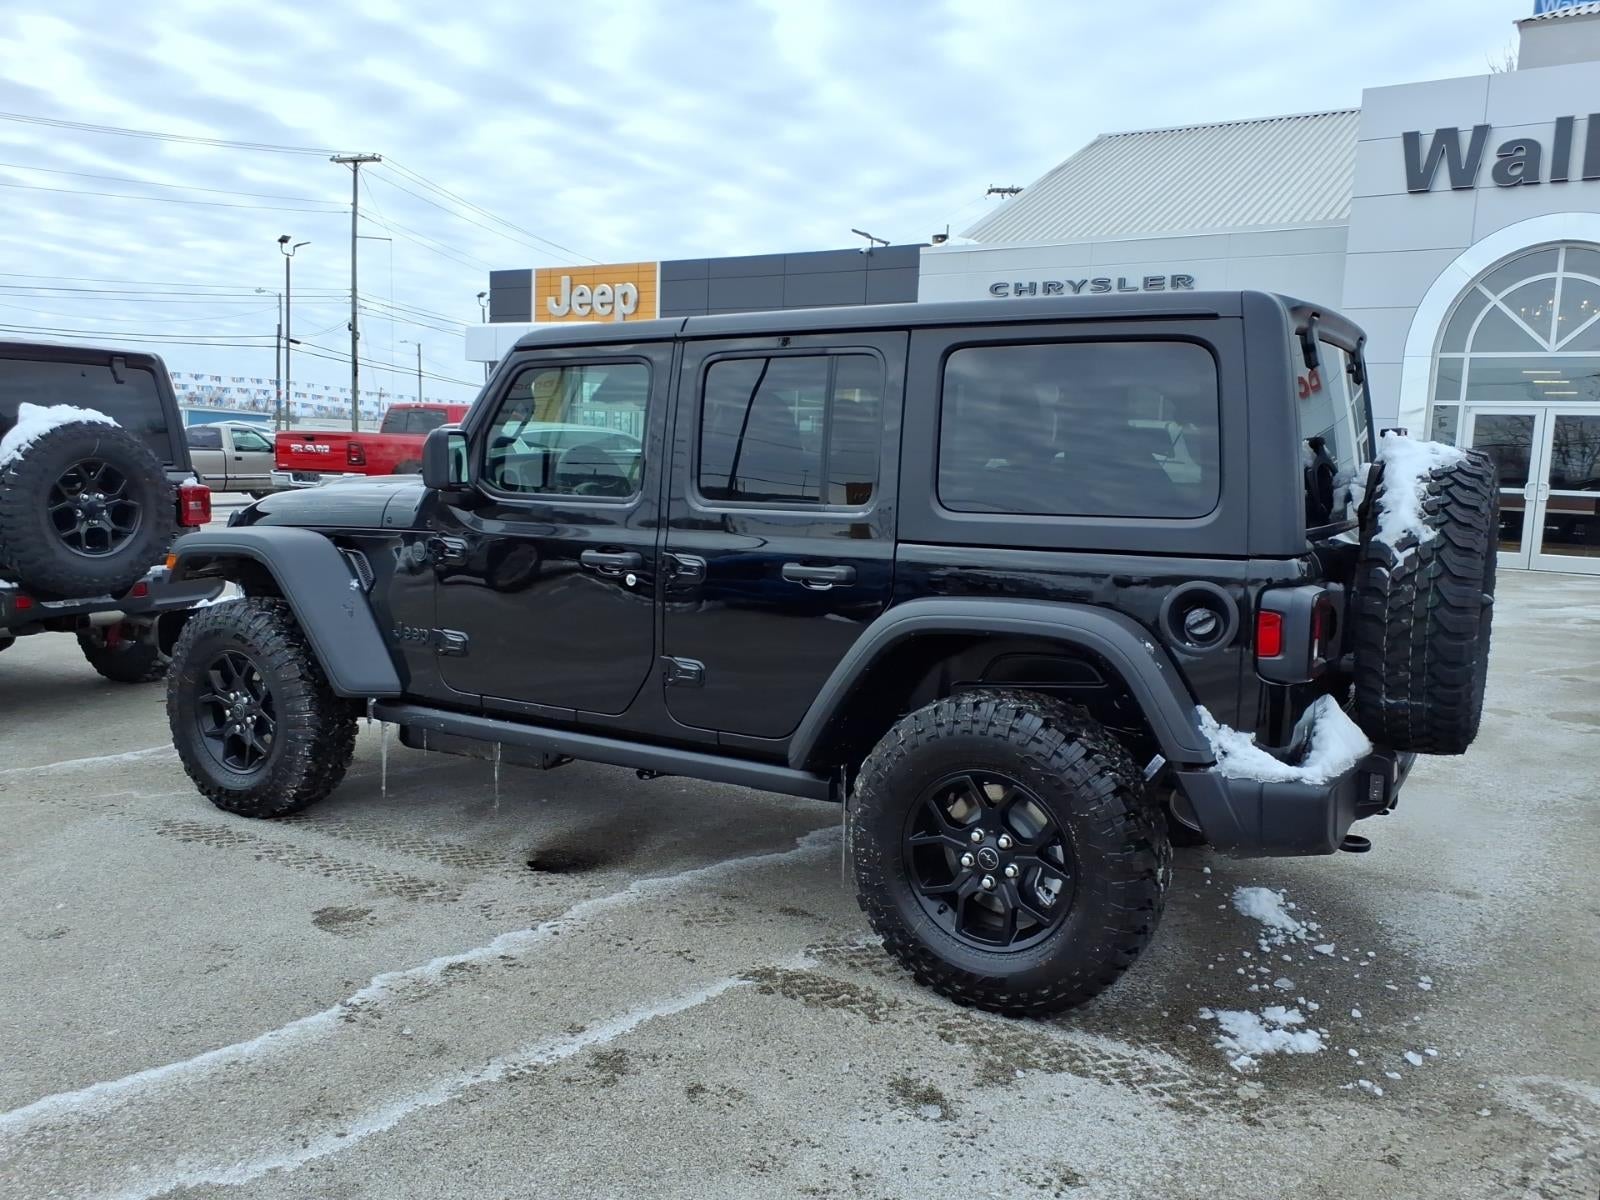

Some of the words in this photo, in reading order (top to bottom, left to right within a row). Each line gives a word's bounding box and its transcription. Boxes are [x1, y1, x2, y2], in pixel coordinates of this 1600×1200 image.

[989, 274, 1194, 298] CHRYSLER
[547, 275, 638, 323] Jeep
[290, 443, 330, 453] RAM
[391, 621, 431, 643] Jeep
